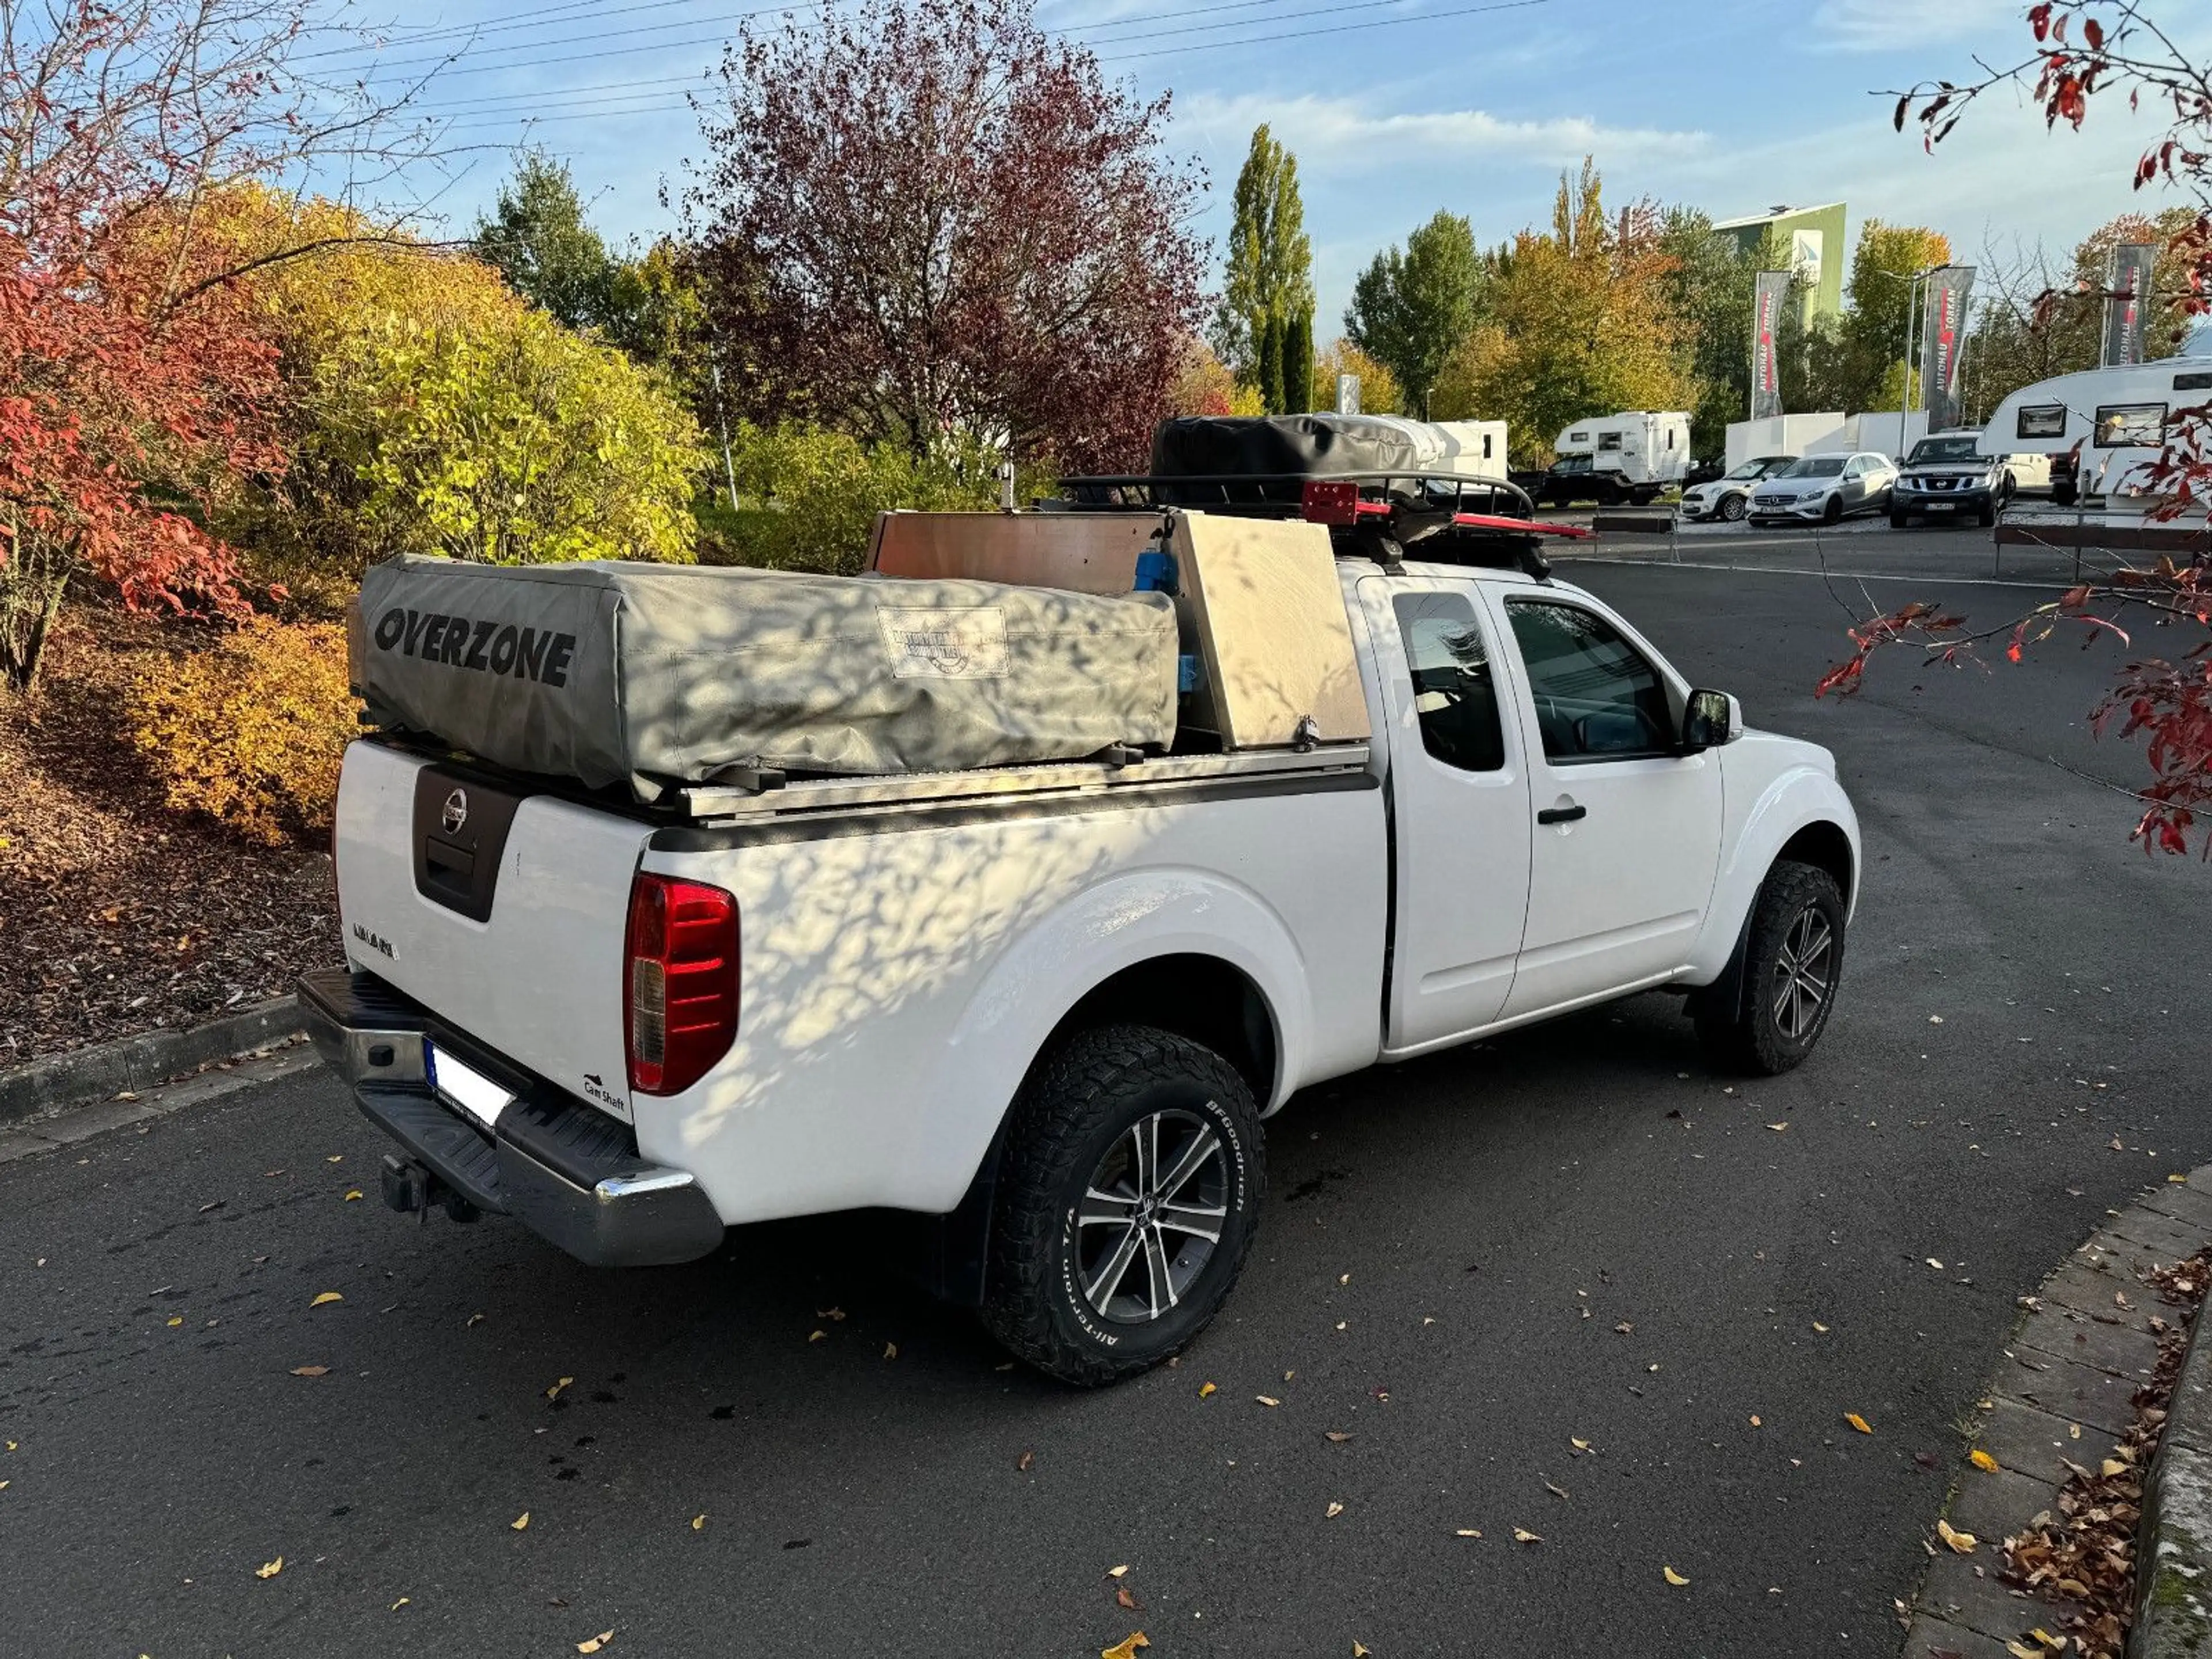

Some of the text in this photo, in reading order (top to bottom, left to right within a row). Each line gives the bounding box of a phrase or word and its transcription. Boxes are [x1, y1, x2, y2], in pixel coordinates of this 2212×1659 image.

[374, 608, 577, 688] OVERZONE
[584, 1082, 624, 1112] Cam Shaft
[1205, 1099, 1245, 1211] BFGoodrich
